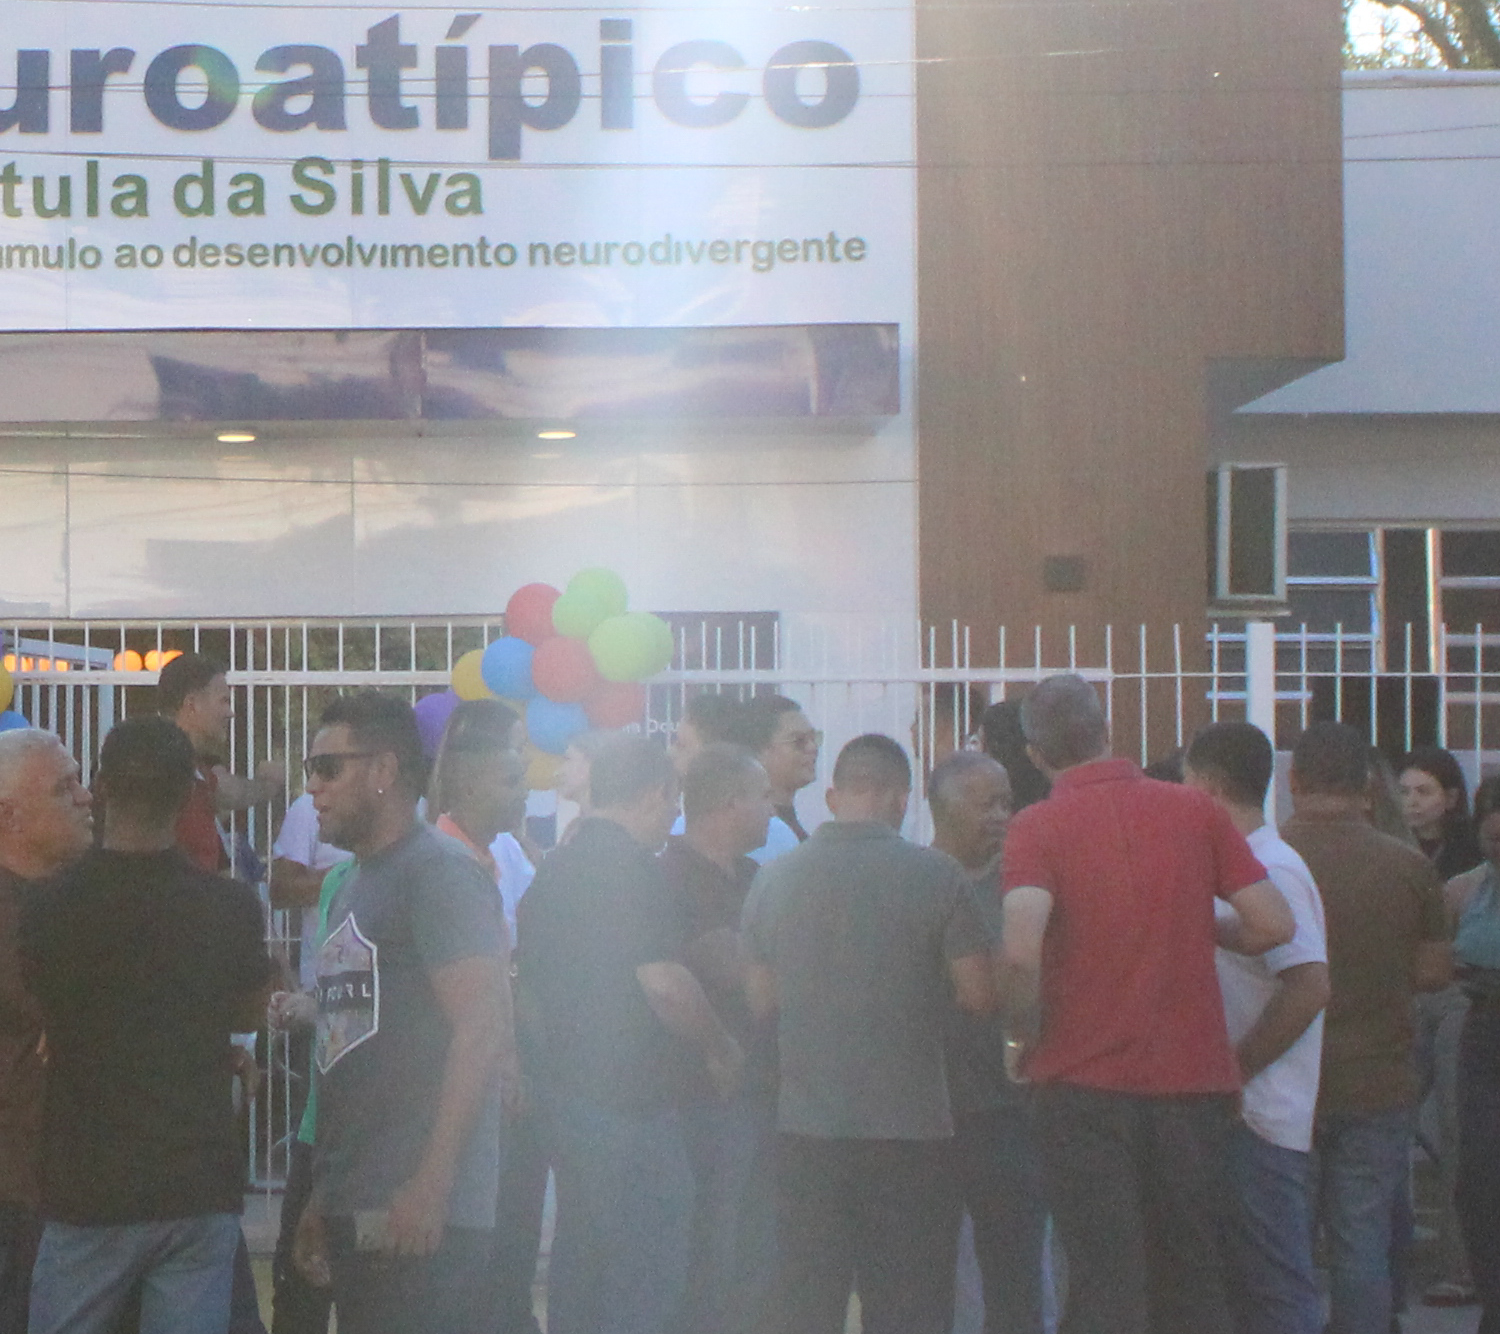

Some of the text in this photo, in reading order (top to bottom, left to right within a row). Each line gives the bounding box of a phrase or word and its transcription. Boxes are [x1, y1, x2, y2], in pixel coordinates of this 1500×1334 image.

[172, 159, 266, 218] da
[290, 155, 484, 217] Silva
[114, 242, 163, 268] ao
